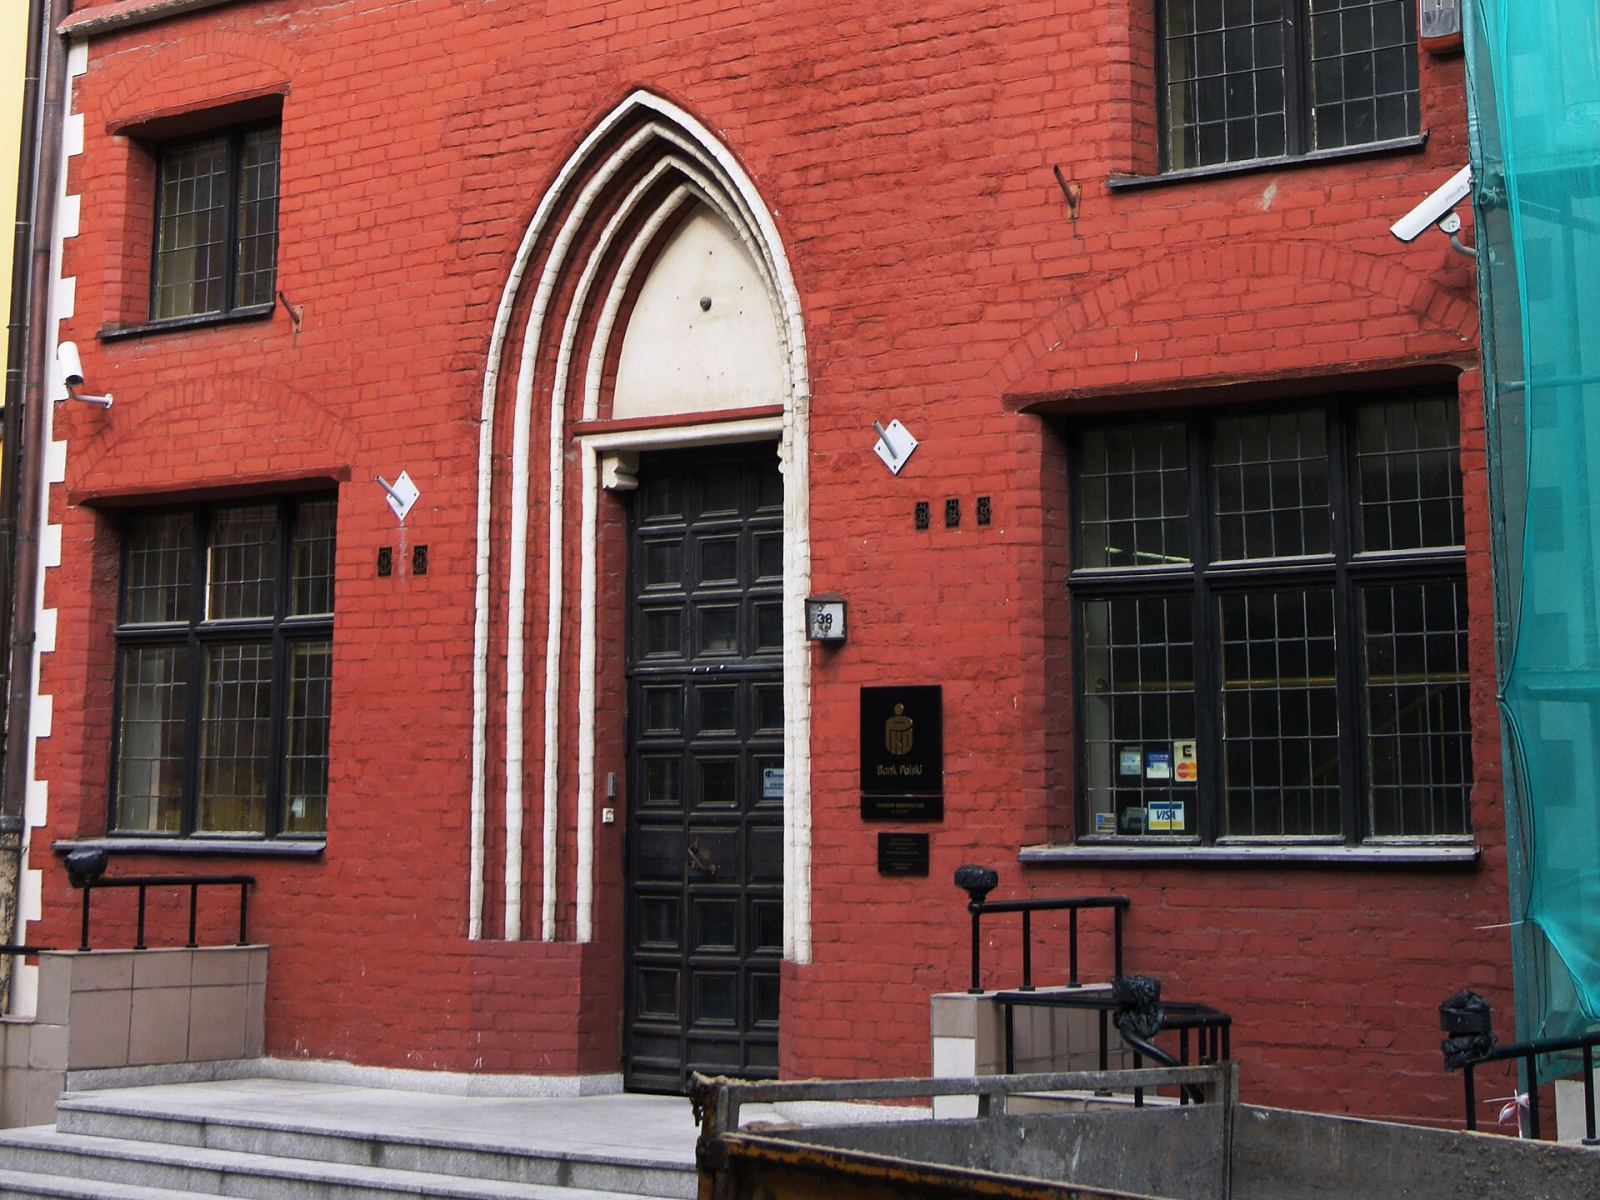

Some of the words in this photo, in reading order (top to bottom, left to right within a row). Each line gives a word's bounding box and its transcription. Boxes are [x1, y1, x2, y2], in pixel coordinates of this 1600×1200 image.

[817, 613, 833, 624] 38
[877, 764, 898, 776] Bank
[899, 763, 923, 776] Polski
[1156, 810, 1176, 820] VISA
